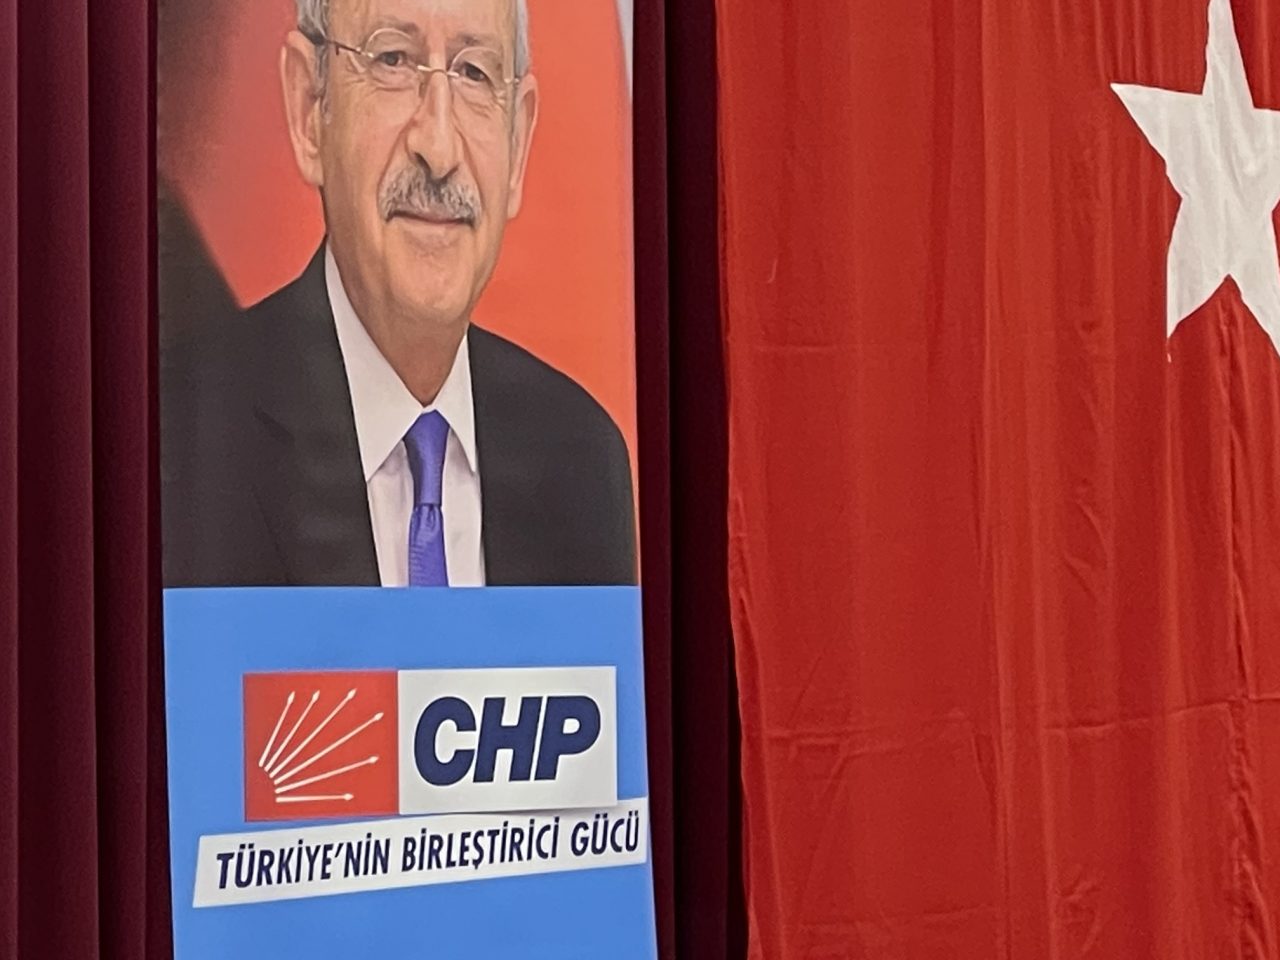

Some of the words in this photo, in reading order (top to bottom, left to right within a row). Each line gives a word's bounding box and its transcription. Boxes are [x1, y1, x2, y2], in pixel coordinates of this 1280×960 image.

[414, 695, 601, 786] CHP
[216, 832, 389, 889] TÜRKİYE'NİN
[401, 816, 559, 873] BİRLEŞTİRİCİ
[570, 810, 640, 857] GÜCÜ
